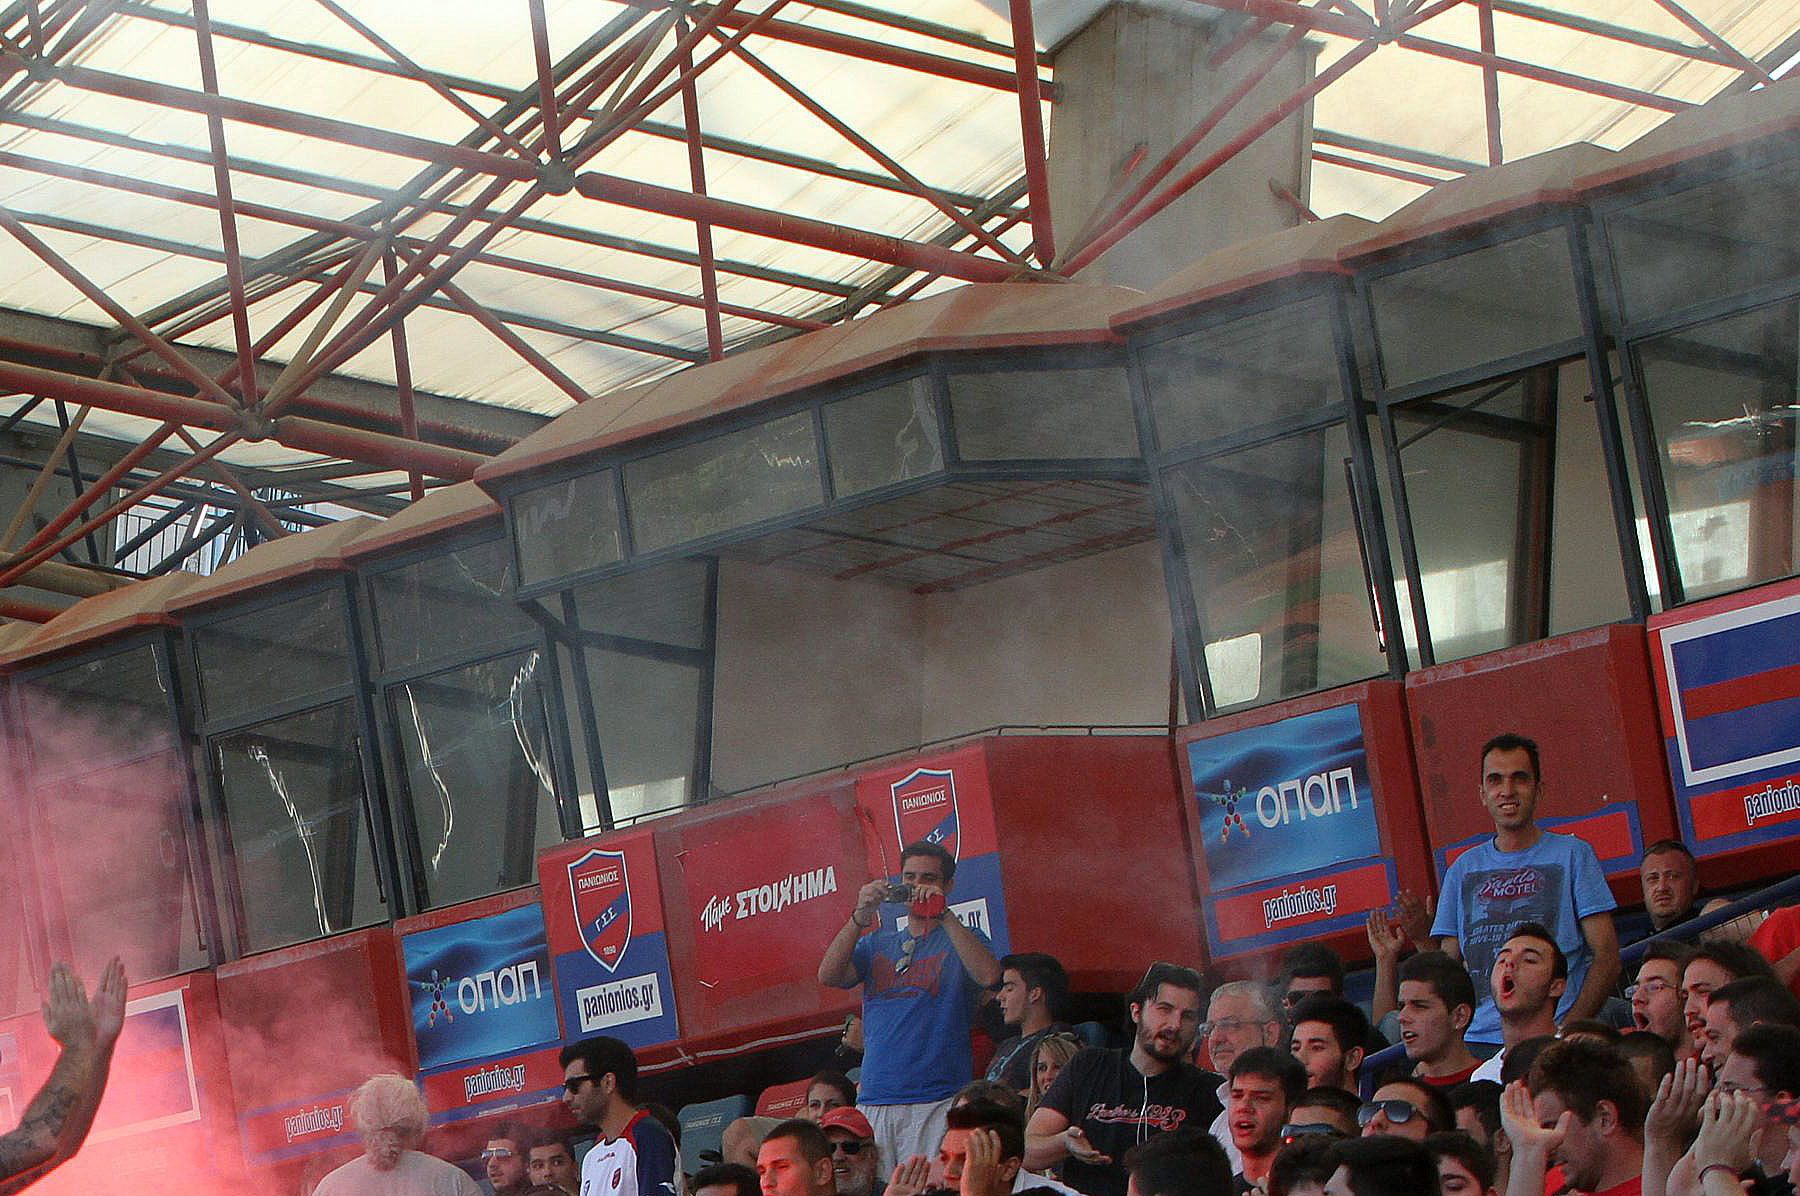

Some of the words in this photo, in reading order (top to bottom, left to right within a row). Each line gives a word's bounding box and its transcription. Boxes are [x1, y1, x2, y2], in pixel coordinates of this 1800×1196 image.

[902, 789, 947, 811] ΠΑΝΙΩΝΙΟΣ
[578, 869, 620, 890] ΠΑΝΙΩΝΙΟΣ
[1493, 883, 1537, 898] MOTEL
[700, 895, 732, 932] Πάμε
[736, 866, 838, 920] ΣΤΟΙΧΗΜΑ
[1263, 885, 1337, 928] panionios.gr
[583, 983, 655, 1026] panionios.gr
[464, 1064, 526, 1103] panionios.gr
[285, 1105, 344, 1143] panionios.gr
